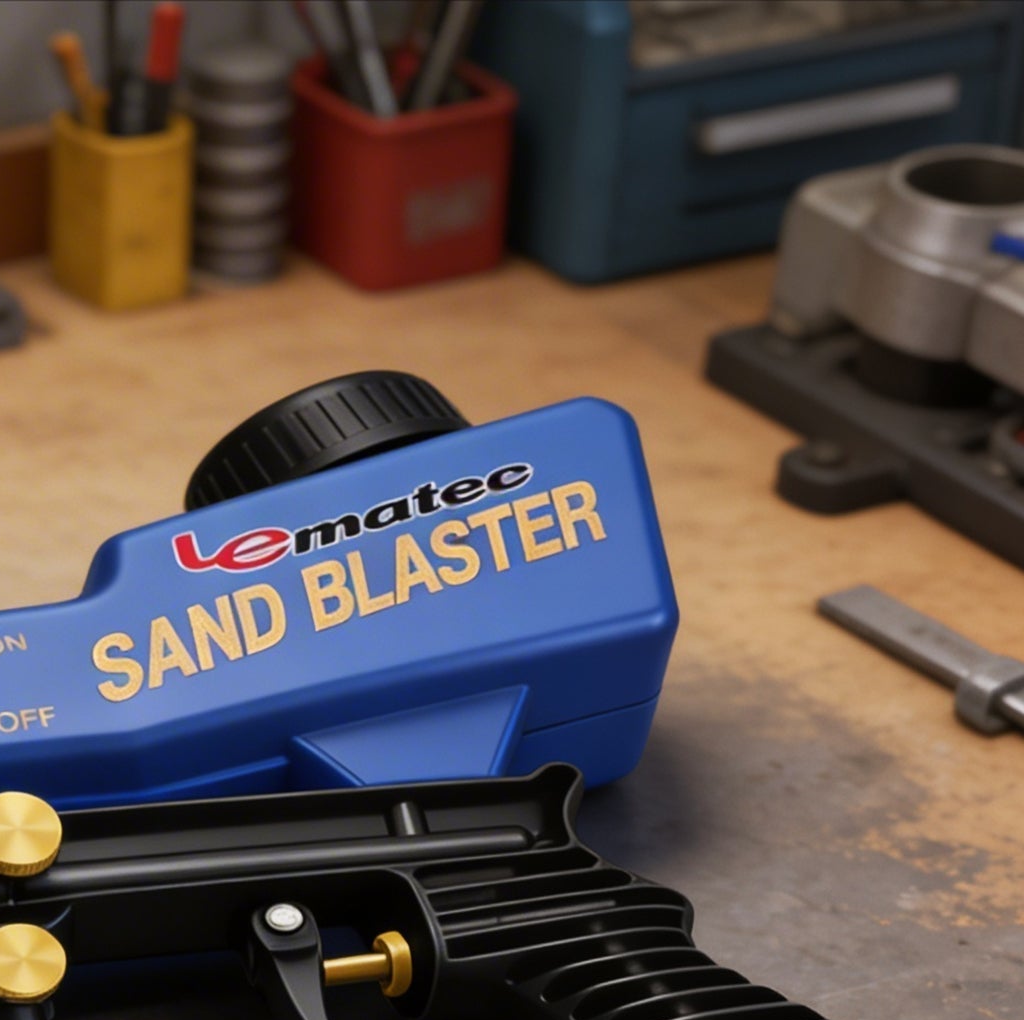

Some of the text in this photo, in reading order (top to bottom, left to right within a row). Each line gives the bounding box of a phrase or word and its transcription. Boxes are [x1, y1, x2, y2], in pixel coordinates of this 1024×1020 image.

[92, 481, 607, 702] SAND BLASTER
[173, 463, 534, 572] Lematec
